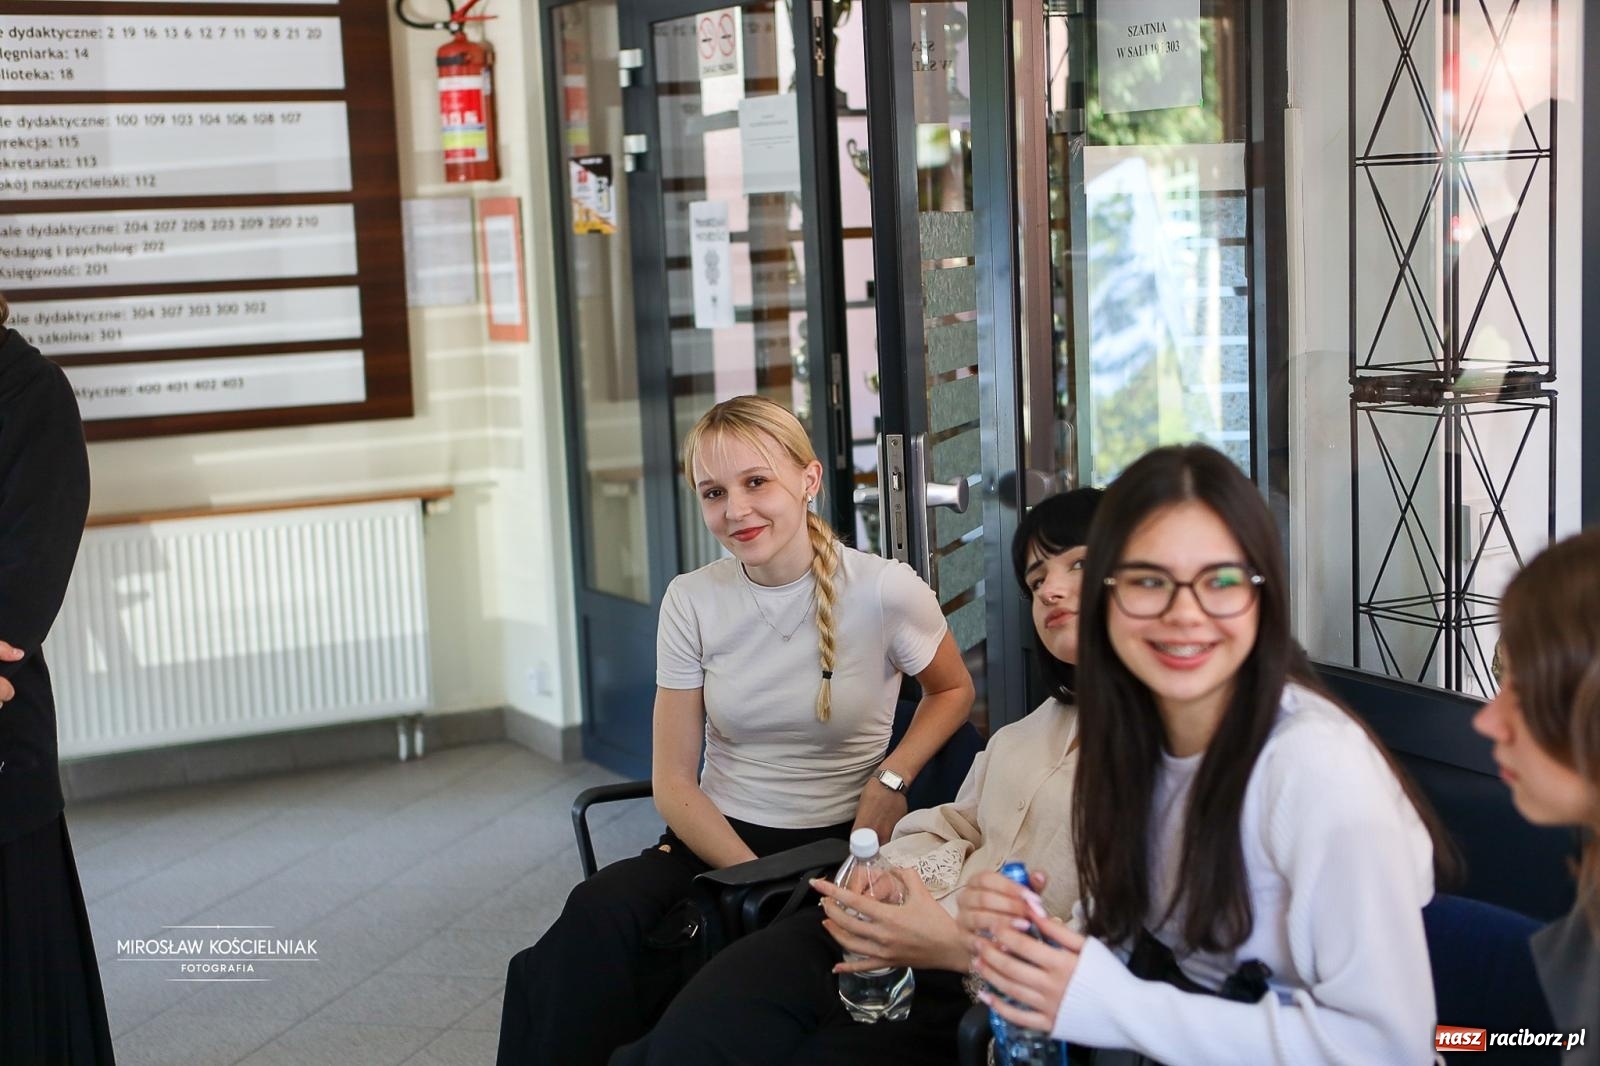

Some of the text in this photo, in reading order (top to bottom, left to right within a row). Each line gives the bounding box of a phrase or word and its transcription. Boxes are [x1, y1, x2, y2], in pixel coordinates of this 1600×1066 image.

[8, 26, 103, 41] dydaktyczne:
[107, 26, 115, 39] 2
[122, 26, 136, 38] 19
[143, 26, 157, 38] 16
[200, 26, 212, 39] 12
[218, 26, 226, 39] 7
[1127, 21, 1167, 38] SZATNIA
[74, 48, 89, 59] 14
[1116, 47, 1126, 59] W
[1166, 40, 1180, 53] 303
[60, 67, 74, 80] 18
[17, 115, 109, 130] dydaktyczne:
[115, 113, 139, 127] 100
[144, 112, 165, 127] 109
[199, 112, 220, 126] 104
[280, 110, 301, 125] 107
[58, 135, 79, 148] 115
[76, 154, 97, 168] 113
[31, 175, 129, 191] nauczycielski:
[135, 174, 156, 188] 112
[26, 221, 119, 239] dydaktyczne:
[124, 219, 148, 233] 204
[153, 218, 177, 233] 207
[65, 241, 136, 258] psycholog:
[142, 240, 165, 254] 202
[85, 262, 108, 276] 201
[34, 309, 126, 328] dydaktyczne:
[132, 305, 155, 320] 304
[100, 327, 122, 340] 301
[137, 383, 161, 395] 400
[167, 381, 188, 393] 401
[194, 379, 216, 391] 402
